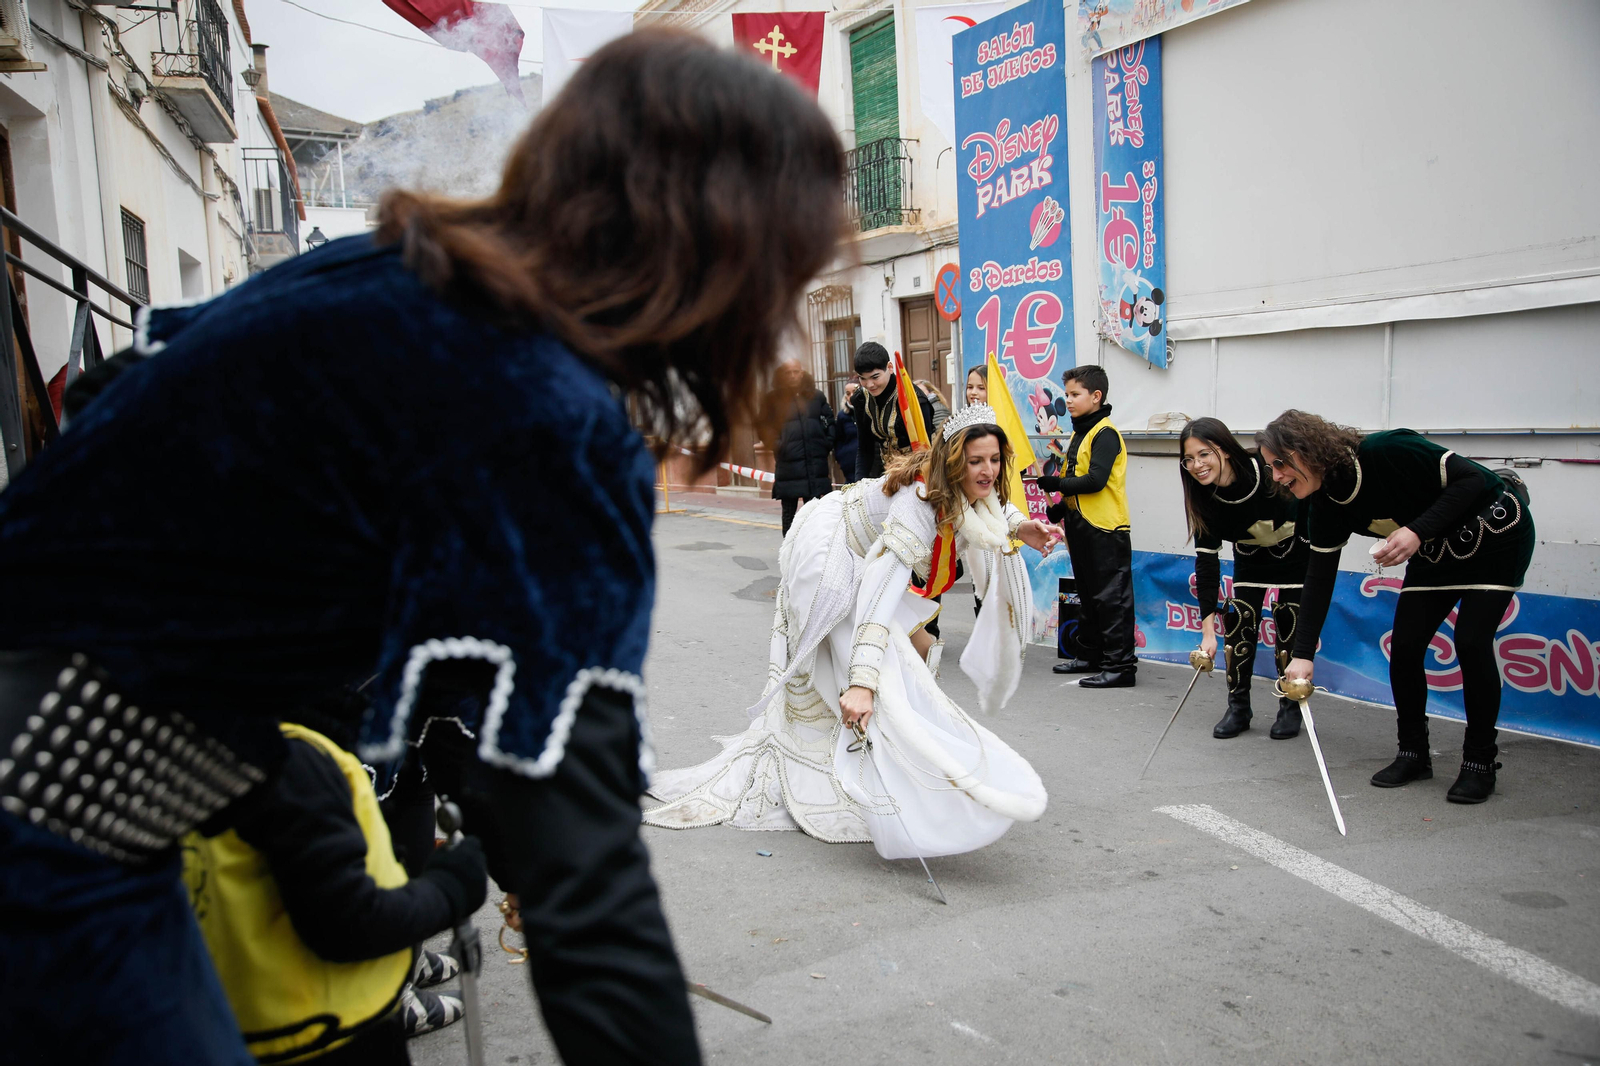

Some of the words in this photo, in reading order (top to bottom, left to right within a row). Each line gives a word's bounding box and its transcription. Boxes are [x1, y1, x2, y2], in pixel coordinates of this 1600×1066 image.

[977, 21, 1034, 65] SALÓN
[987, 43, 1056, 89] JUEGOS
[961, 70, 984, 99] DE
[975, 153, 1054, 220] PARK
[1142, 161, 1155, 179] 3
[1101, 171, 1140, 271] 1€
[1142, 177, 1158, 269] Dardos
[969, 267, 983, 292] 3
[982, 256, 1063, 292] Dardos
[976, 290, 1064, 381] 1€
